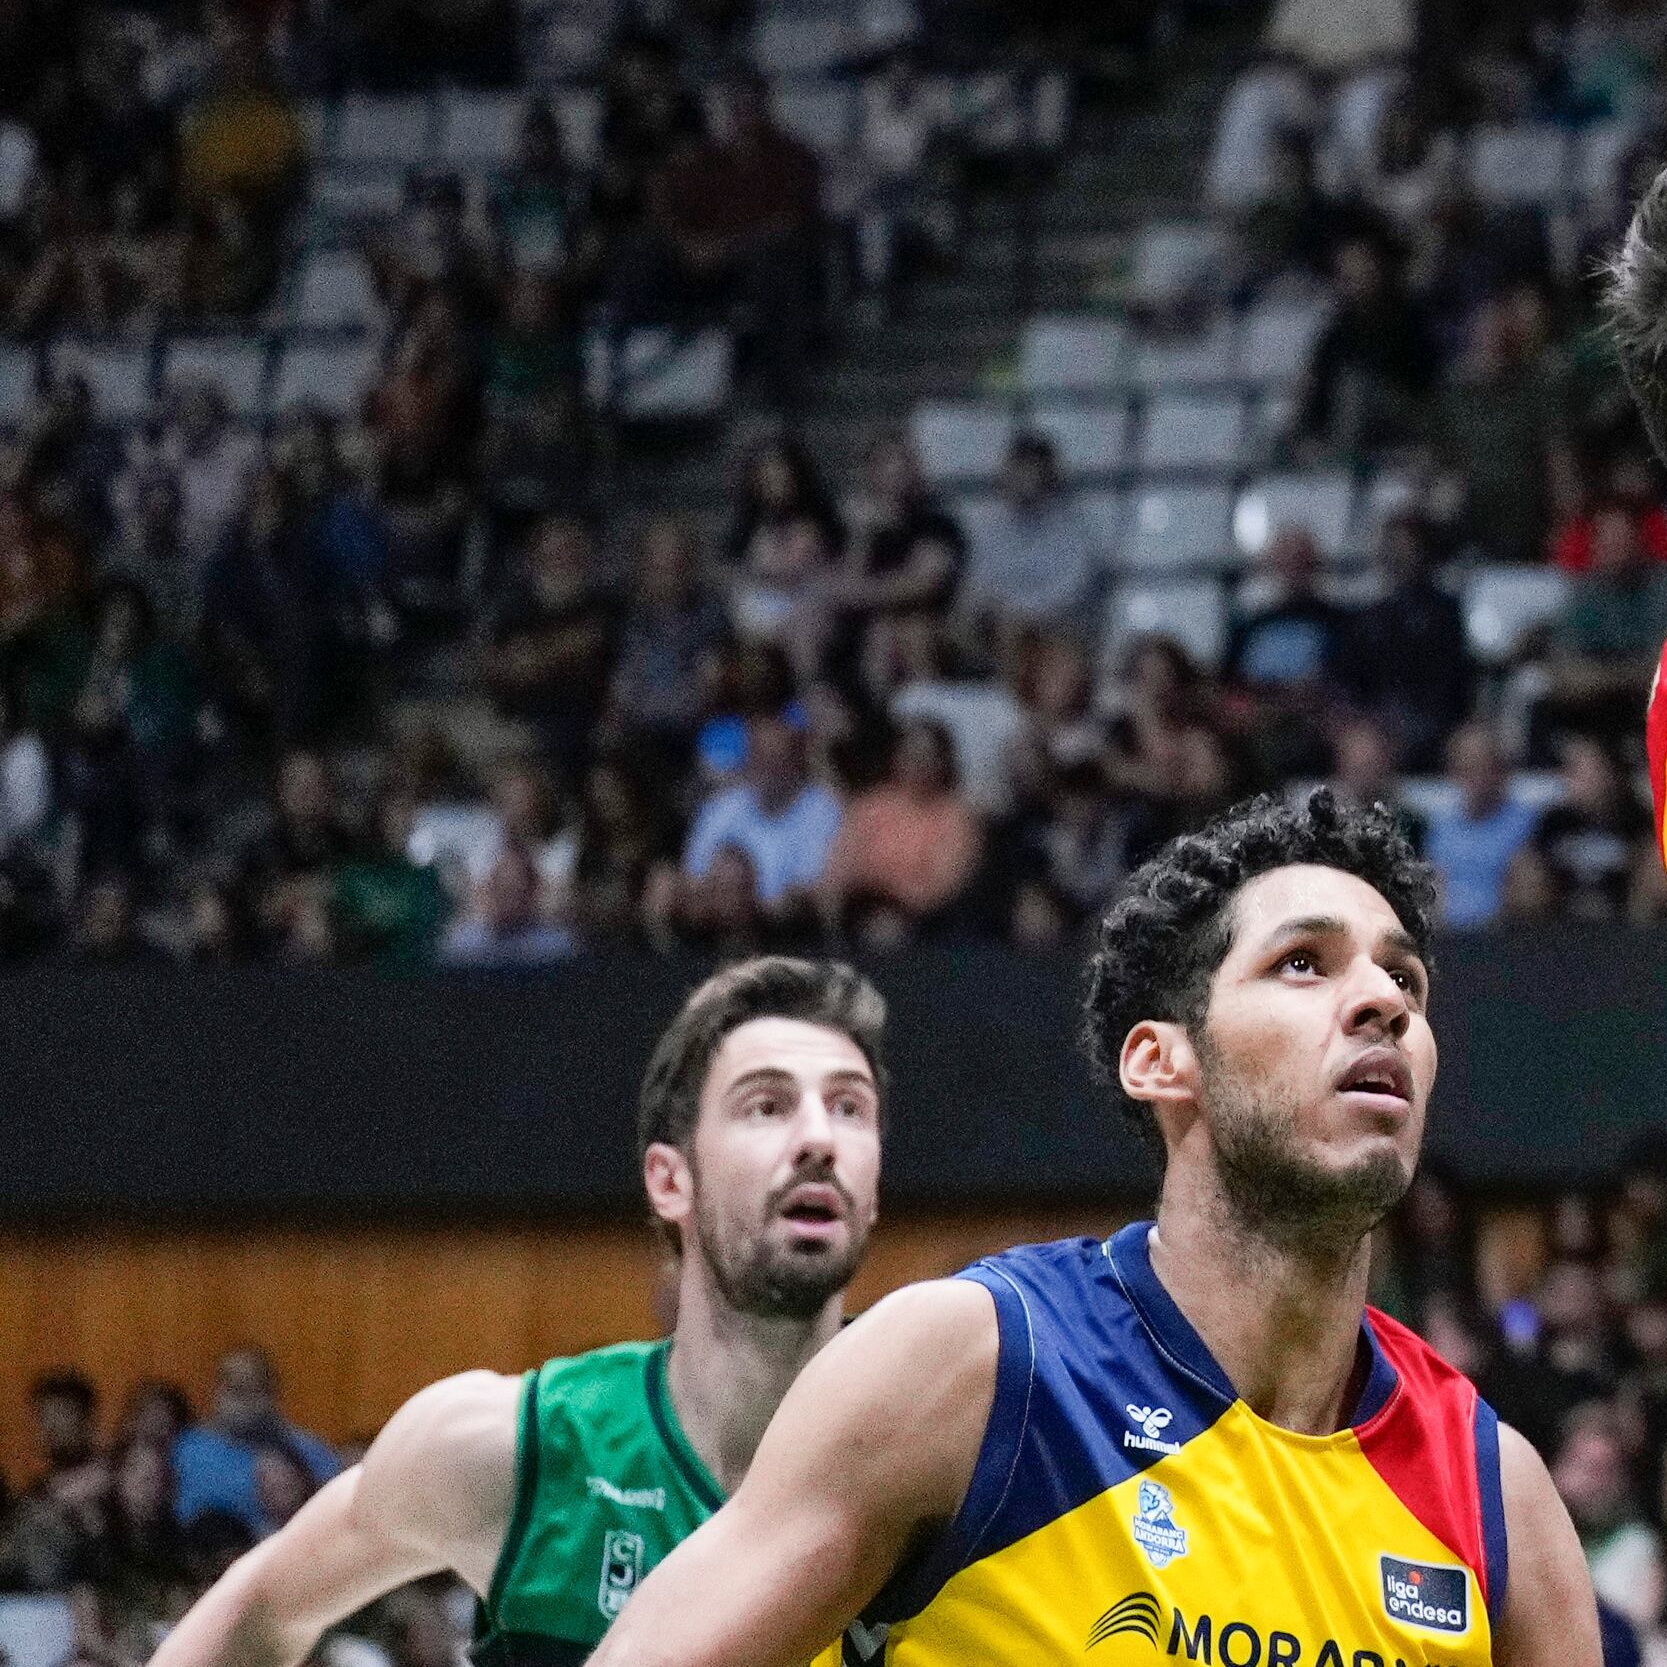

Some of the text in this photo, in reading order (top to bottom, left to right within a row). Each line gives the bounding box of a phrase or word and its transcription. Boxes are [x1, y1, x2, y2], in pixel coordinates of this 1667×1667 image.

[1123, 1430, 1181, 1456] hummel
[1386, 1574, 1418, 1600] liga
[1388, 1596, 1462, 1626] endesa
